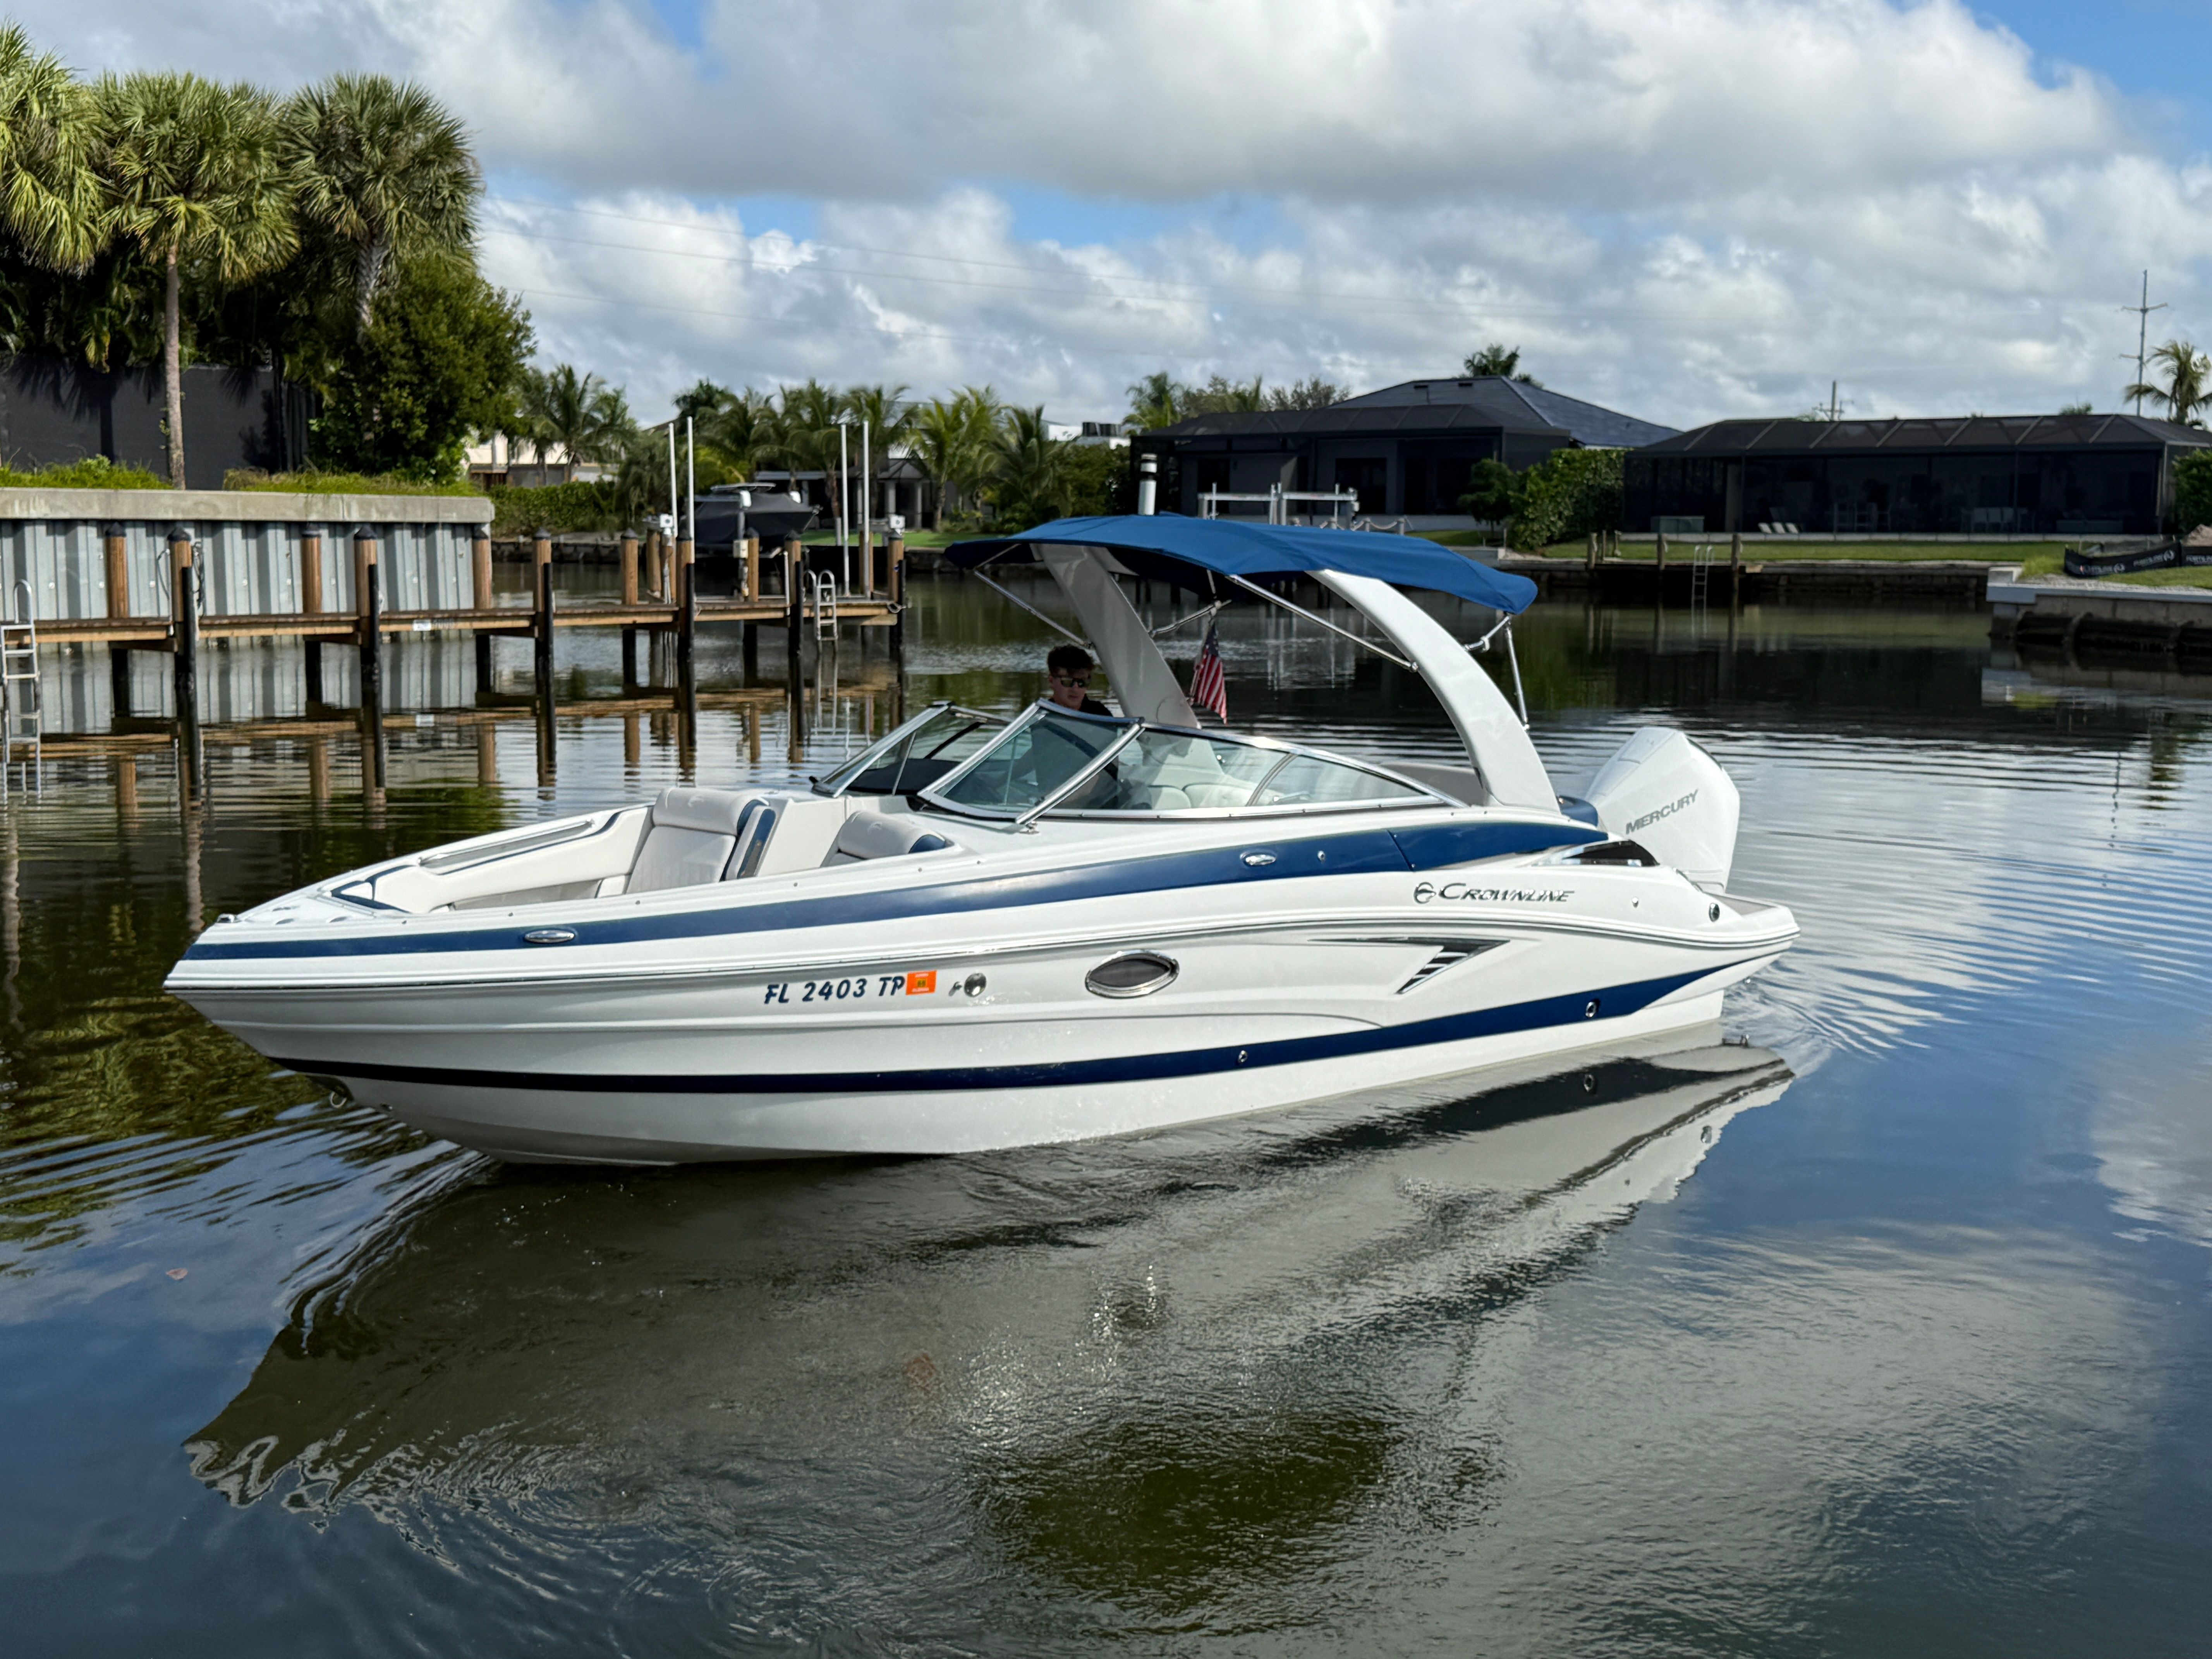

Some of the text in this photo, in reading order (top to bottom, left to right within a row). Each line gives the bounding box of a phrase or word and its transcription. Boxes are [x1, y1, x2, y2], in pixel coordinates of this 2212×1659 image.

[1626, 789, 1698, 835] MERCURY
[1438, 883, 1575, 902] CROWNLINE
[764, 975, 905, 1005] FL 2403 TP
